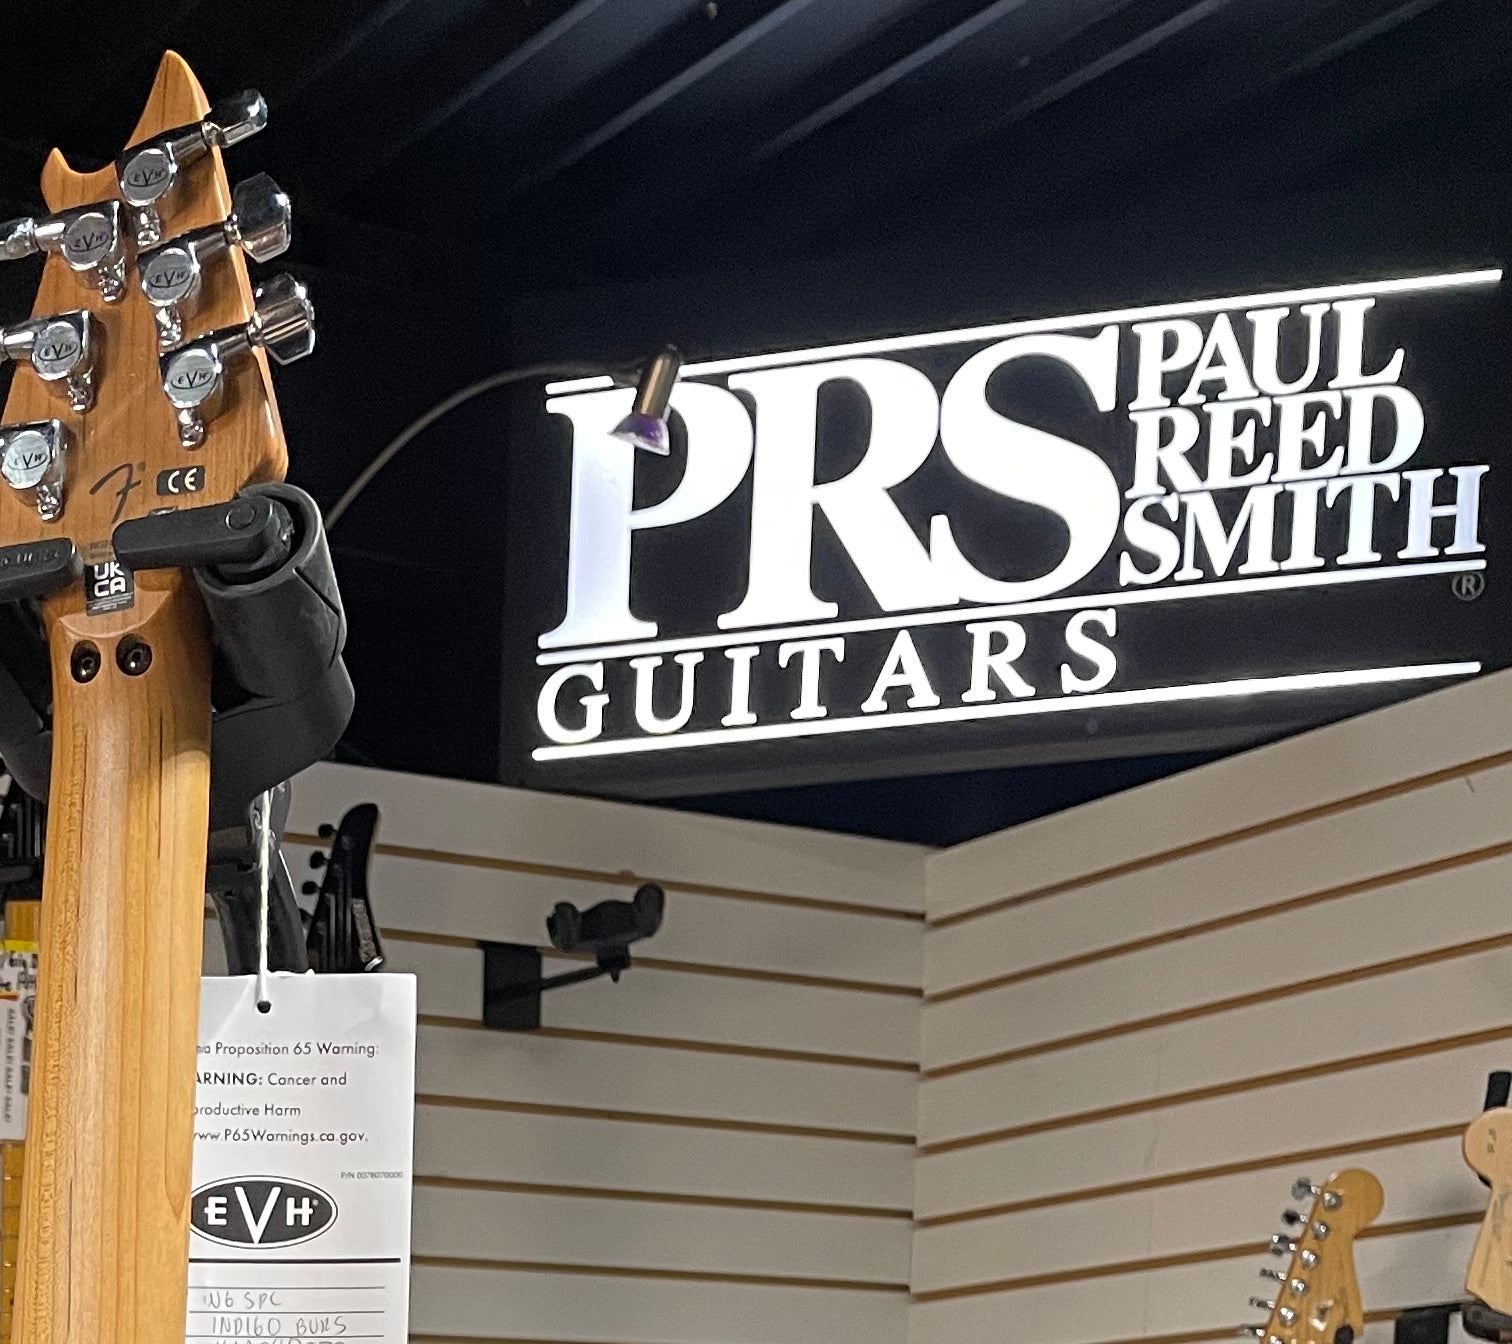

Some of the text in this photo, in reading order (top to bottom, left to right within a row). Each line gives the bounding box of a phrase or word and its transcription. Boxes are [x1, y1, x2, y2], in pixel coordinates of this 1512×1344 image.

[1130, 298, 1405, 410] PAUL
[1125, 385, 1425, 500] REED
[167, 467, 197, 494] CE
[538, 324, 1120, 649] PRS
[1118, 464, 1490, 586] SMITH
[94, 562, 125, 580] UK
[94, 577, 126, 597] CA
[537, 607, 1120, 746] GUITARS
[216, 1041, 289, 1058] Proposition
[293, 1041, 312, 1055] 65
[316, 1041, 380, 1058] Warning:
[196, 1072, 347, 1086] ARNING: Cancer and
[264, 1103, 301, 1116] Harm
[204, 1186, 314, 1245] EVH
